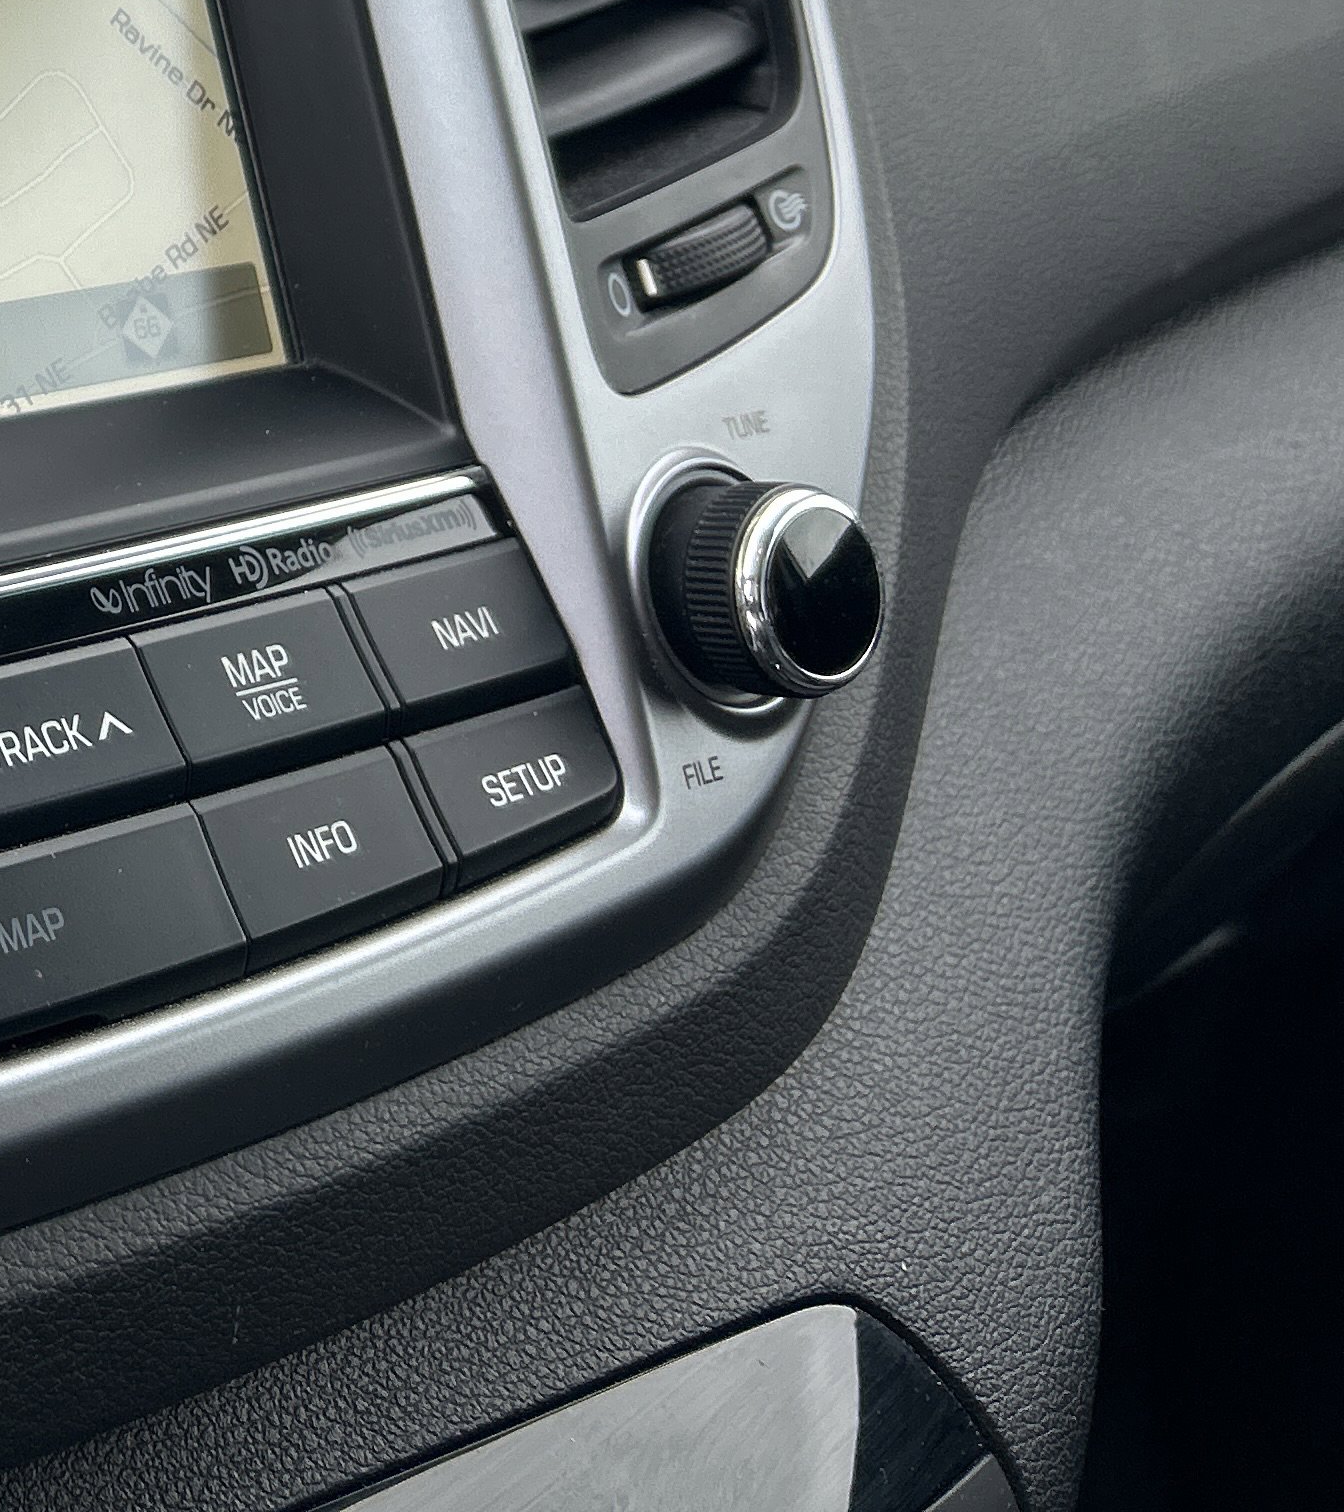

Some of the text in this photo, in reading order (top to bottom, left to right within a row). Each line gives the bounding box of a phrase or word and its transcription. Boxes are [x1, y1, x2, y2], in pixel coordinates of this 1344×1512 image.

[109, 7, 184, 85] Ravine
[185, 79, 216, 111] Dr
[164, 234, 200, 269] Rd
[194, 205, 230, 244] NE
[34, 356, 74, 397] NE
[721, 409, 771, 441] TUNE
[265, 537, 333, 576] Radio
[118, 565, 212, 614] Infinity
[430, 605, 500, 651] NAVI
[220, 644, 289, 688] MAP
[241, 687, 308, 721] VOICE
[480, 753, 567, 808] SETUP
[681, 755, 724, 790] FILE
[285, 820, 358, 869] INFO
